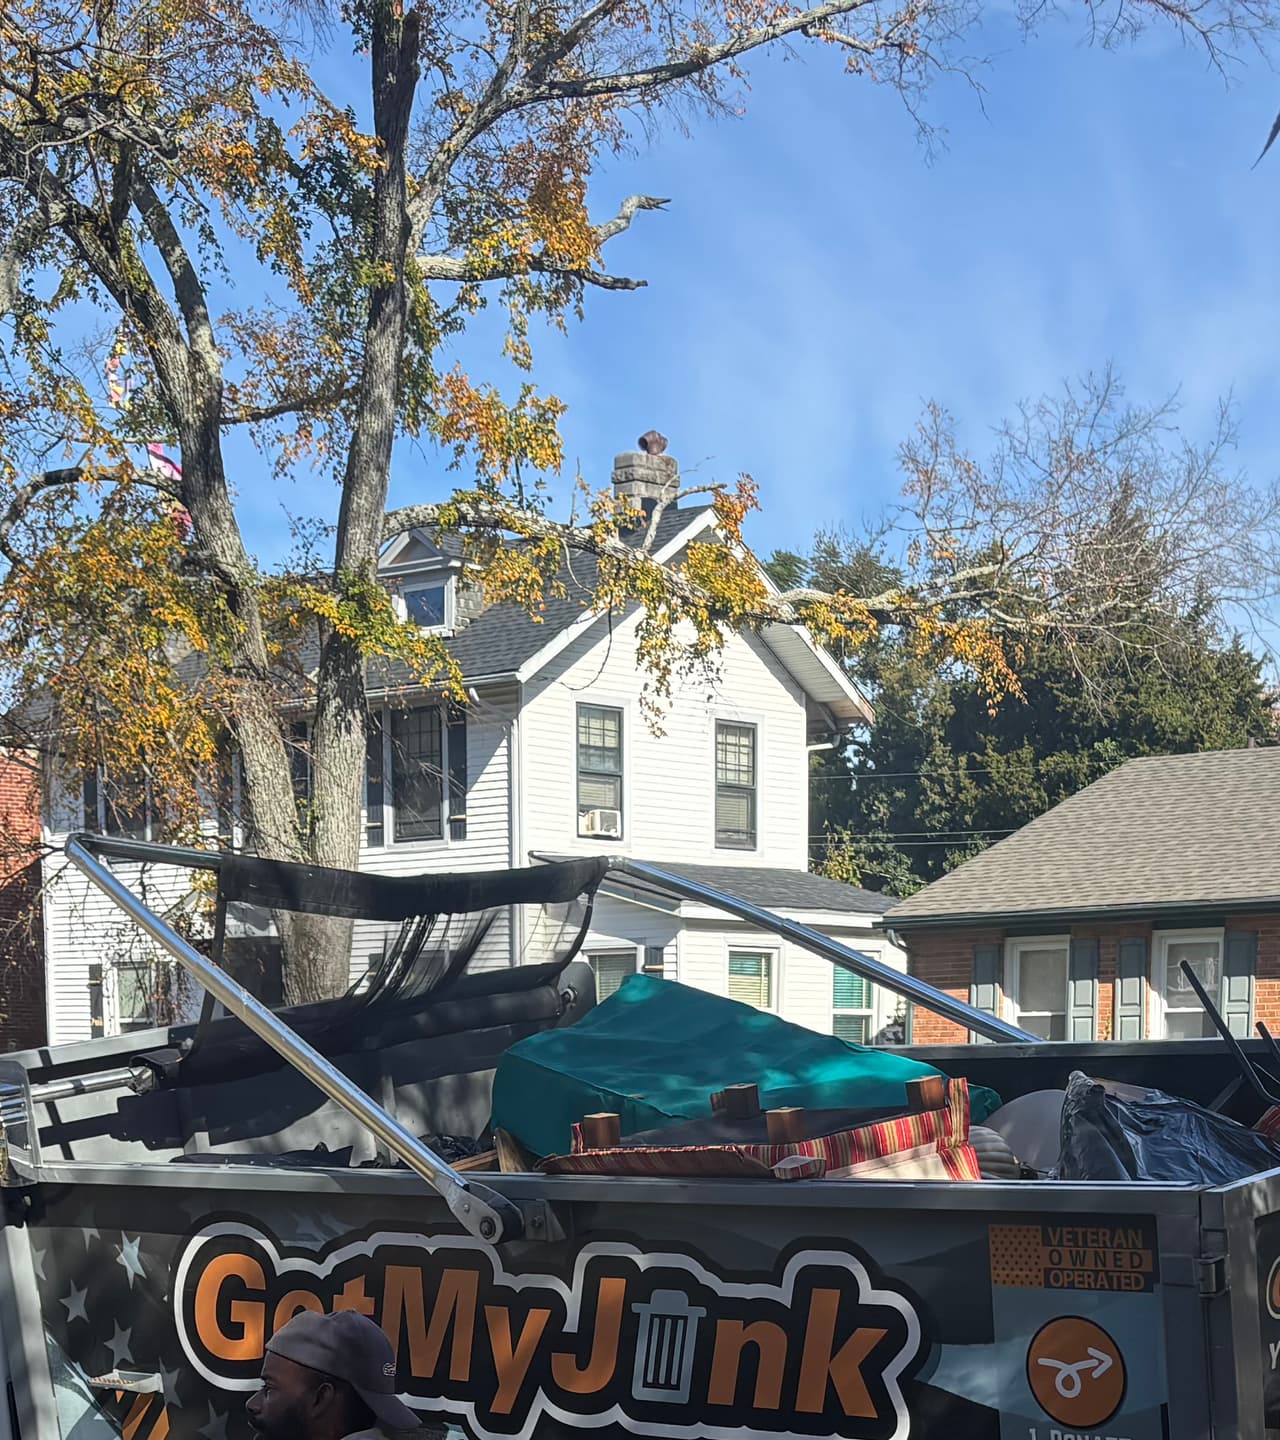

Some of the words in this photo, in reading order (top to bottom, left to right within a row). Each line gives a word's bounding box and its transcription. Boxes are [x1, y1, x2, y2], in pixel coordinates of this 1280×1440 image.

[1048, 1227, 1143, 1249] VETERAN
[1049, 1249, 1144, 1269] OWNED
[1050, 1270, 1145, 1291] OPERATED
